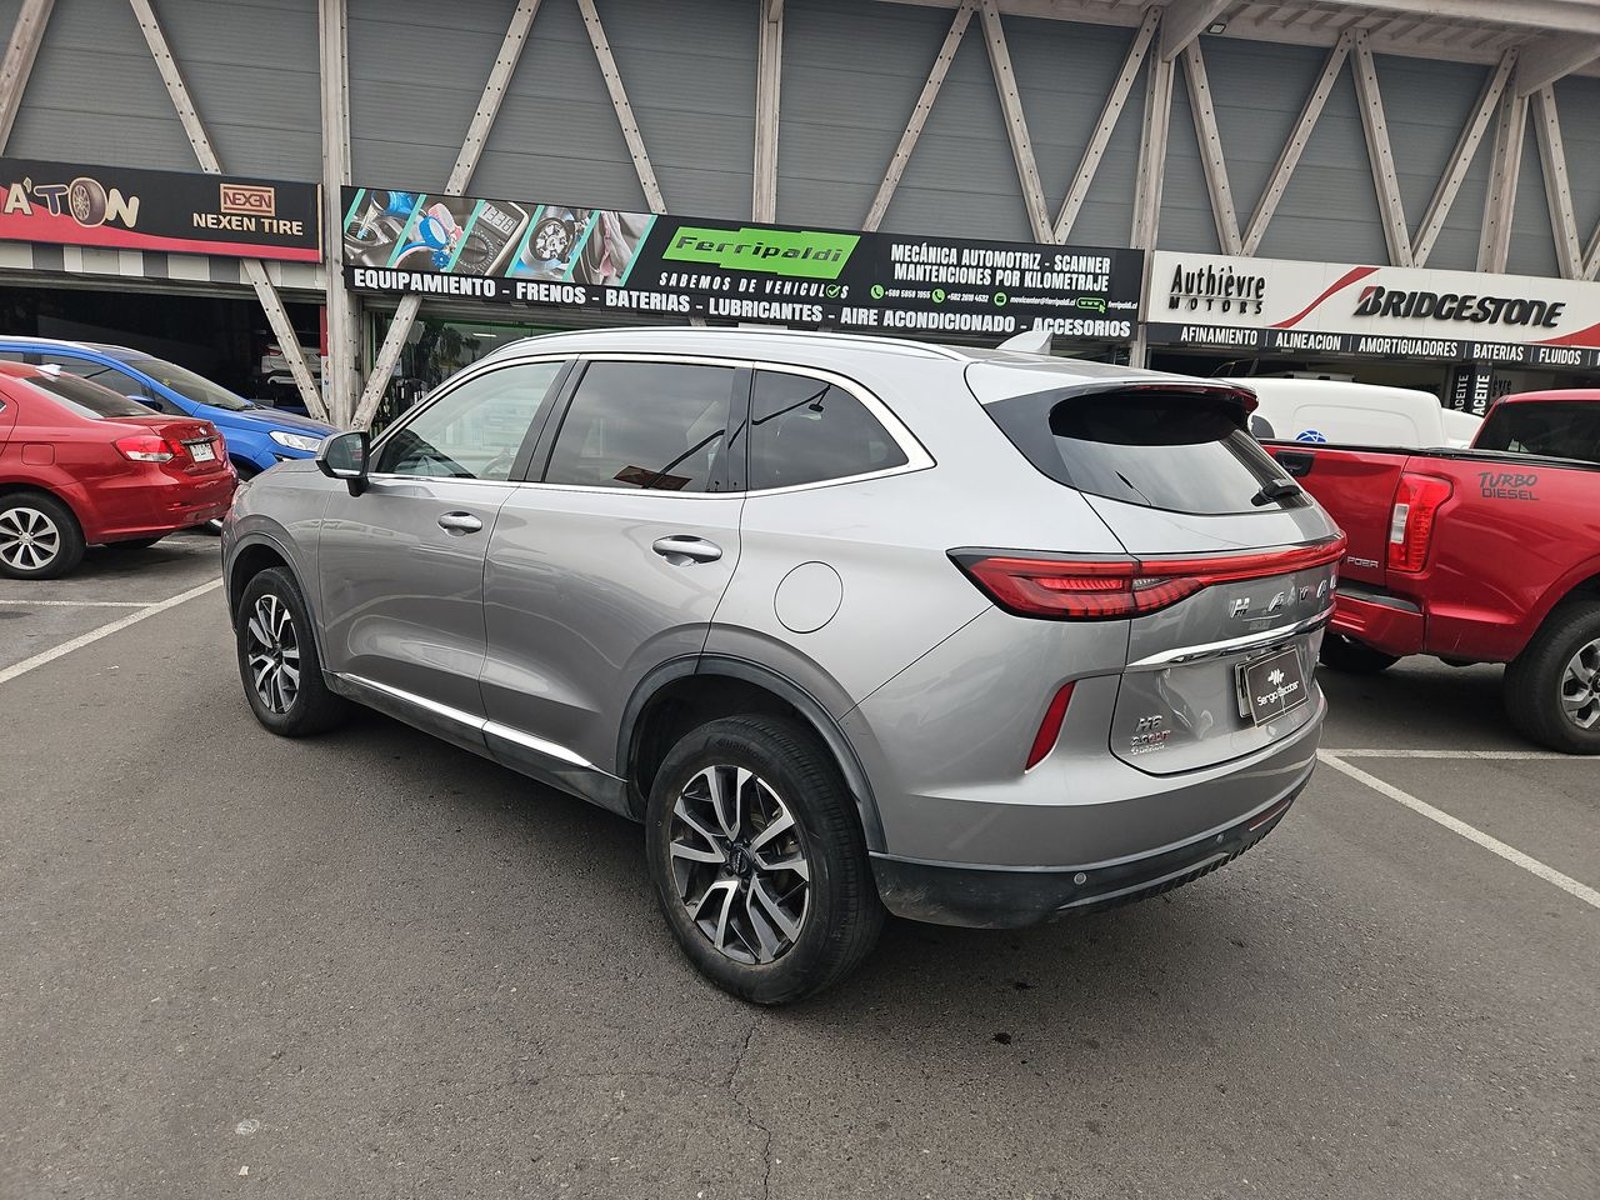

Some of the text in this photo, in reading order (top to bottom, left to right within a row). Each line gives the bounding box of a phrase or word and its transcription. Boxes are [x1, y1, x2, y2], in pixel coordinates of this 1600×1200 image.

[223, 190, 272, 209] NEXEN
[193, 213, 303, 236] NEXEN TIRE
[676, 236, 843, 262] Ferripaldi
[890, 242, 1111, 274] MECÁNICA AUTOMOTRIZ SCANNER
[659, 272, 731, 291] SABEMOS
[738, 278, 757, 292] DE
[894, 263, 1110, 292] MANTENCIONES POR KILOMETRAJE
[1170, 264, 1265, 299] Authièvre
[354, 270, 1131, 338] EQUIPAMIENTO FRENOS BATERIAS LUBRICANTES AIRE ACONDICIONADO ACCESORIOS
[1168, 296, 1263, 315] MOTORS
[1354, 285, 1567, 328] BRIDGESTONE
[1181, 326, 1258, 346] AFINAMIENTO
[1275, 332, 1341, 351] ALINEACION
[1358, 337, 1457, 357] AMORTIGUADORES
[1473, 343, 1524, 361] BATERIAS
[1539, 347, 1581, 365] FLUIDOS
[1454, 374, 1469, 412] ACEITE
[1472, 374, 1490, 416] ACEITE
[1479, 472, 1538, 488] TURBO
[1481, 487, 1540, 500] DIESEL
[1347, 556, 1379, 569] POER
